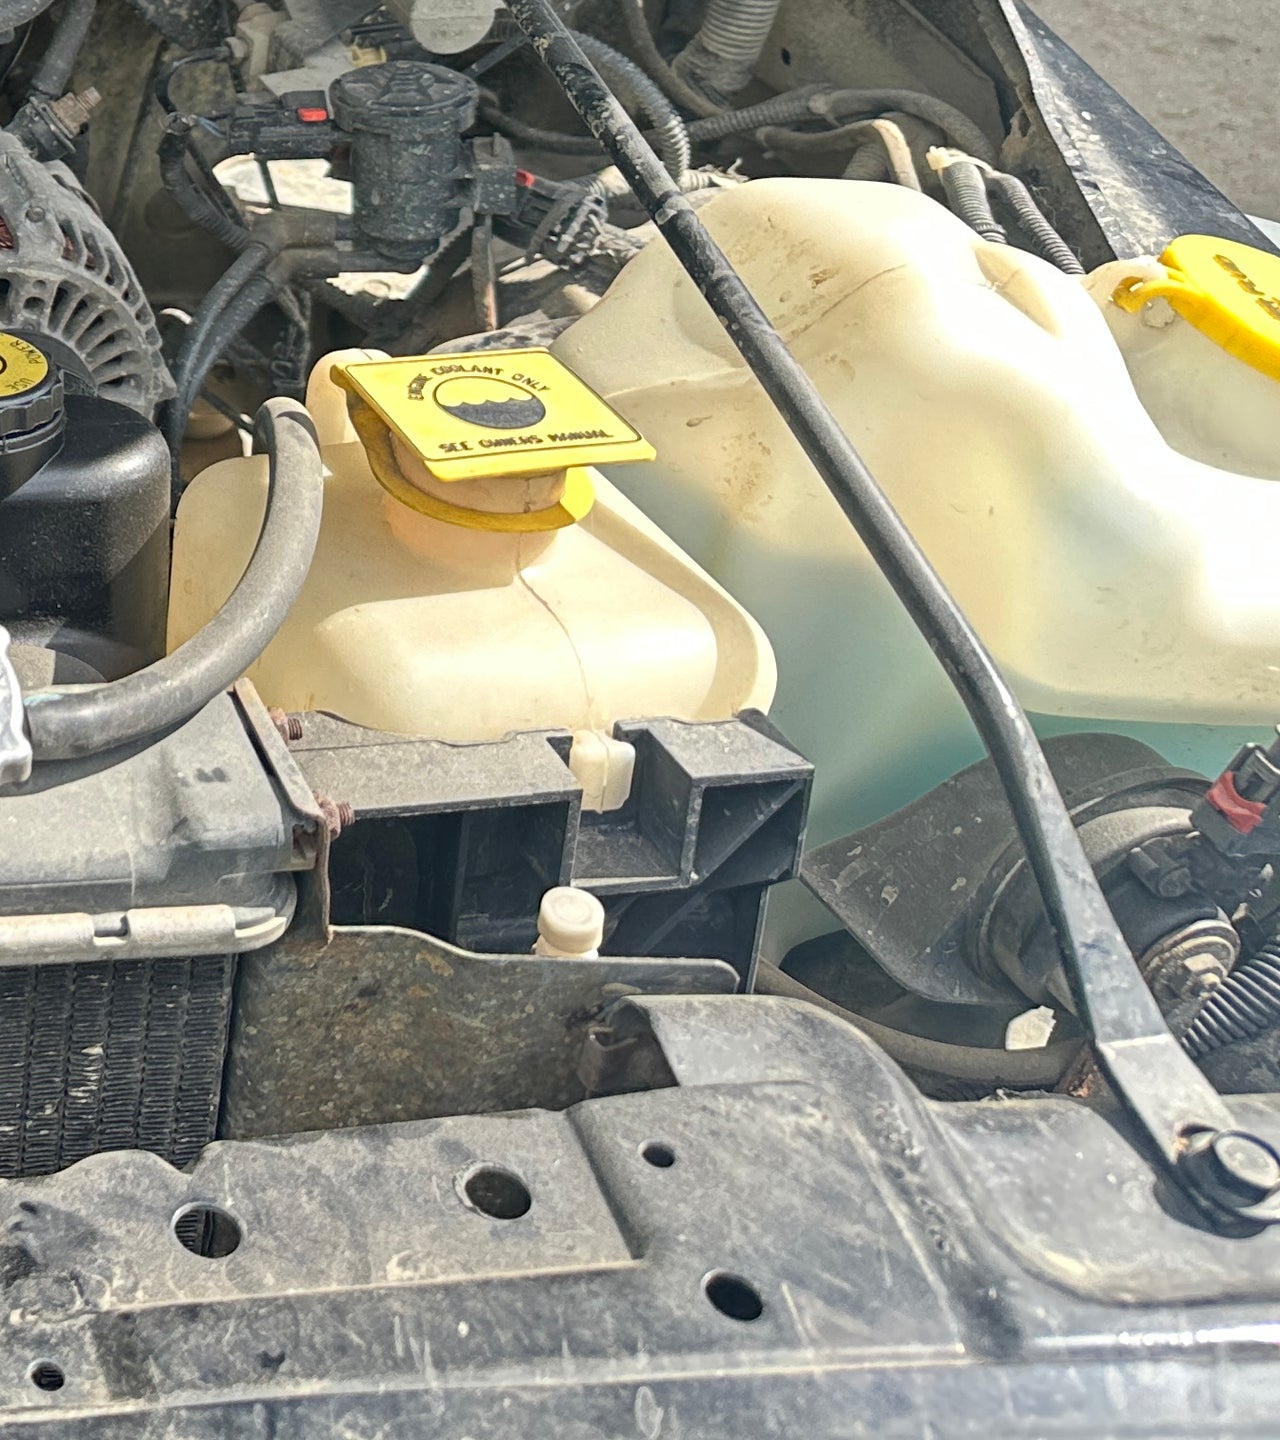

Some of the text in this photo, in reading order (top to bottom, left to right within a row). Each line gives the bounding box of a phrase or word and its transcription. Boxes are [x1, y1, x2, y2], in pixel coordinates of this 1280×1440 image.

[10, 340, 45, 365] POWER
[6, 377, 36, 392] USE
[430, 363, 505, 377] COOLANT
[511, 374, 552, 393] ONLY
[438, 441, 474, 454] SEE
[547, 428, 615, 443] MANUAL
